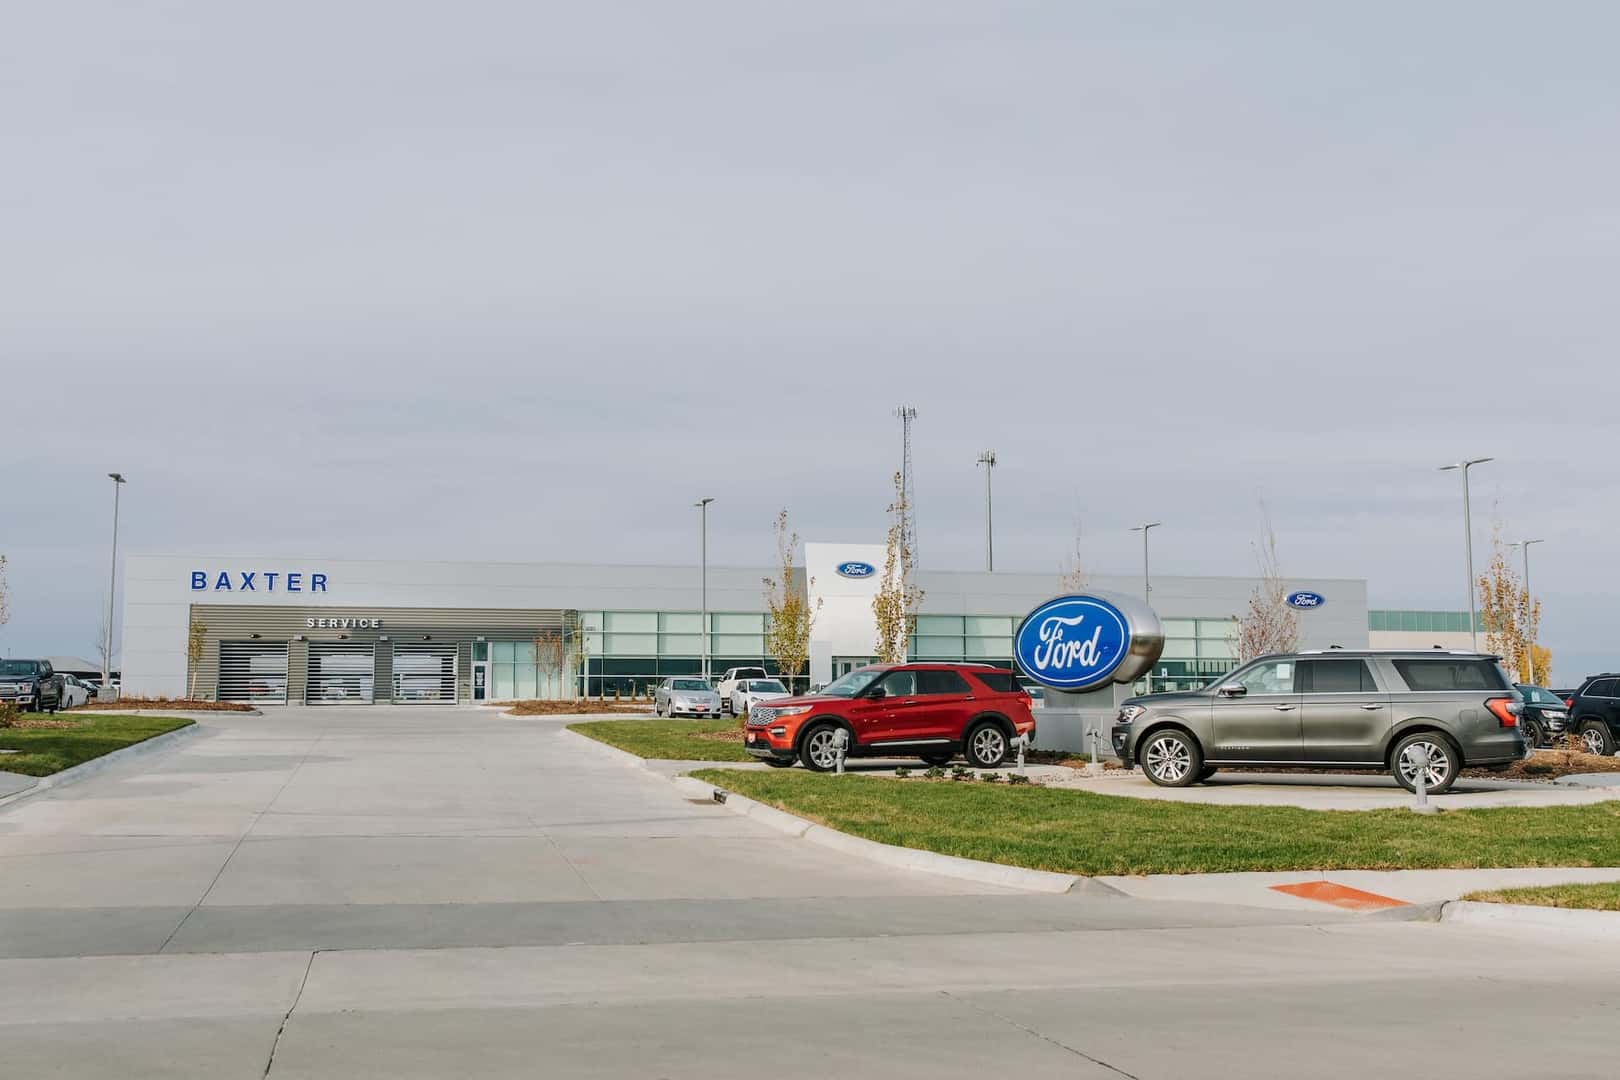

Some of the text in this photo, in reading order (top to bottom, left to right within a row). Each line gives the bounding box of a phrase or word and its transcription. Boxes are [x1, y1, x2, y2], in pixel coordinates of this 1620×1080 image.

[844, 564, 867, 574] Ford
[191, 571, 328, 592] BAXTER
[1294, 594, 1317, 605] Ford
[306, 617, 380, 628] SERVICE
[1034, 615, 1102, 670] Ford
